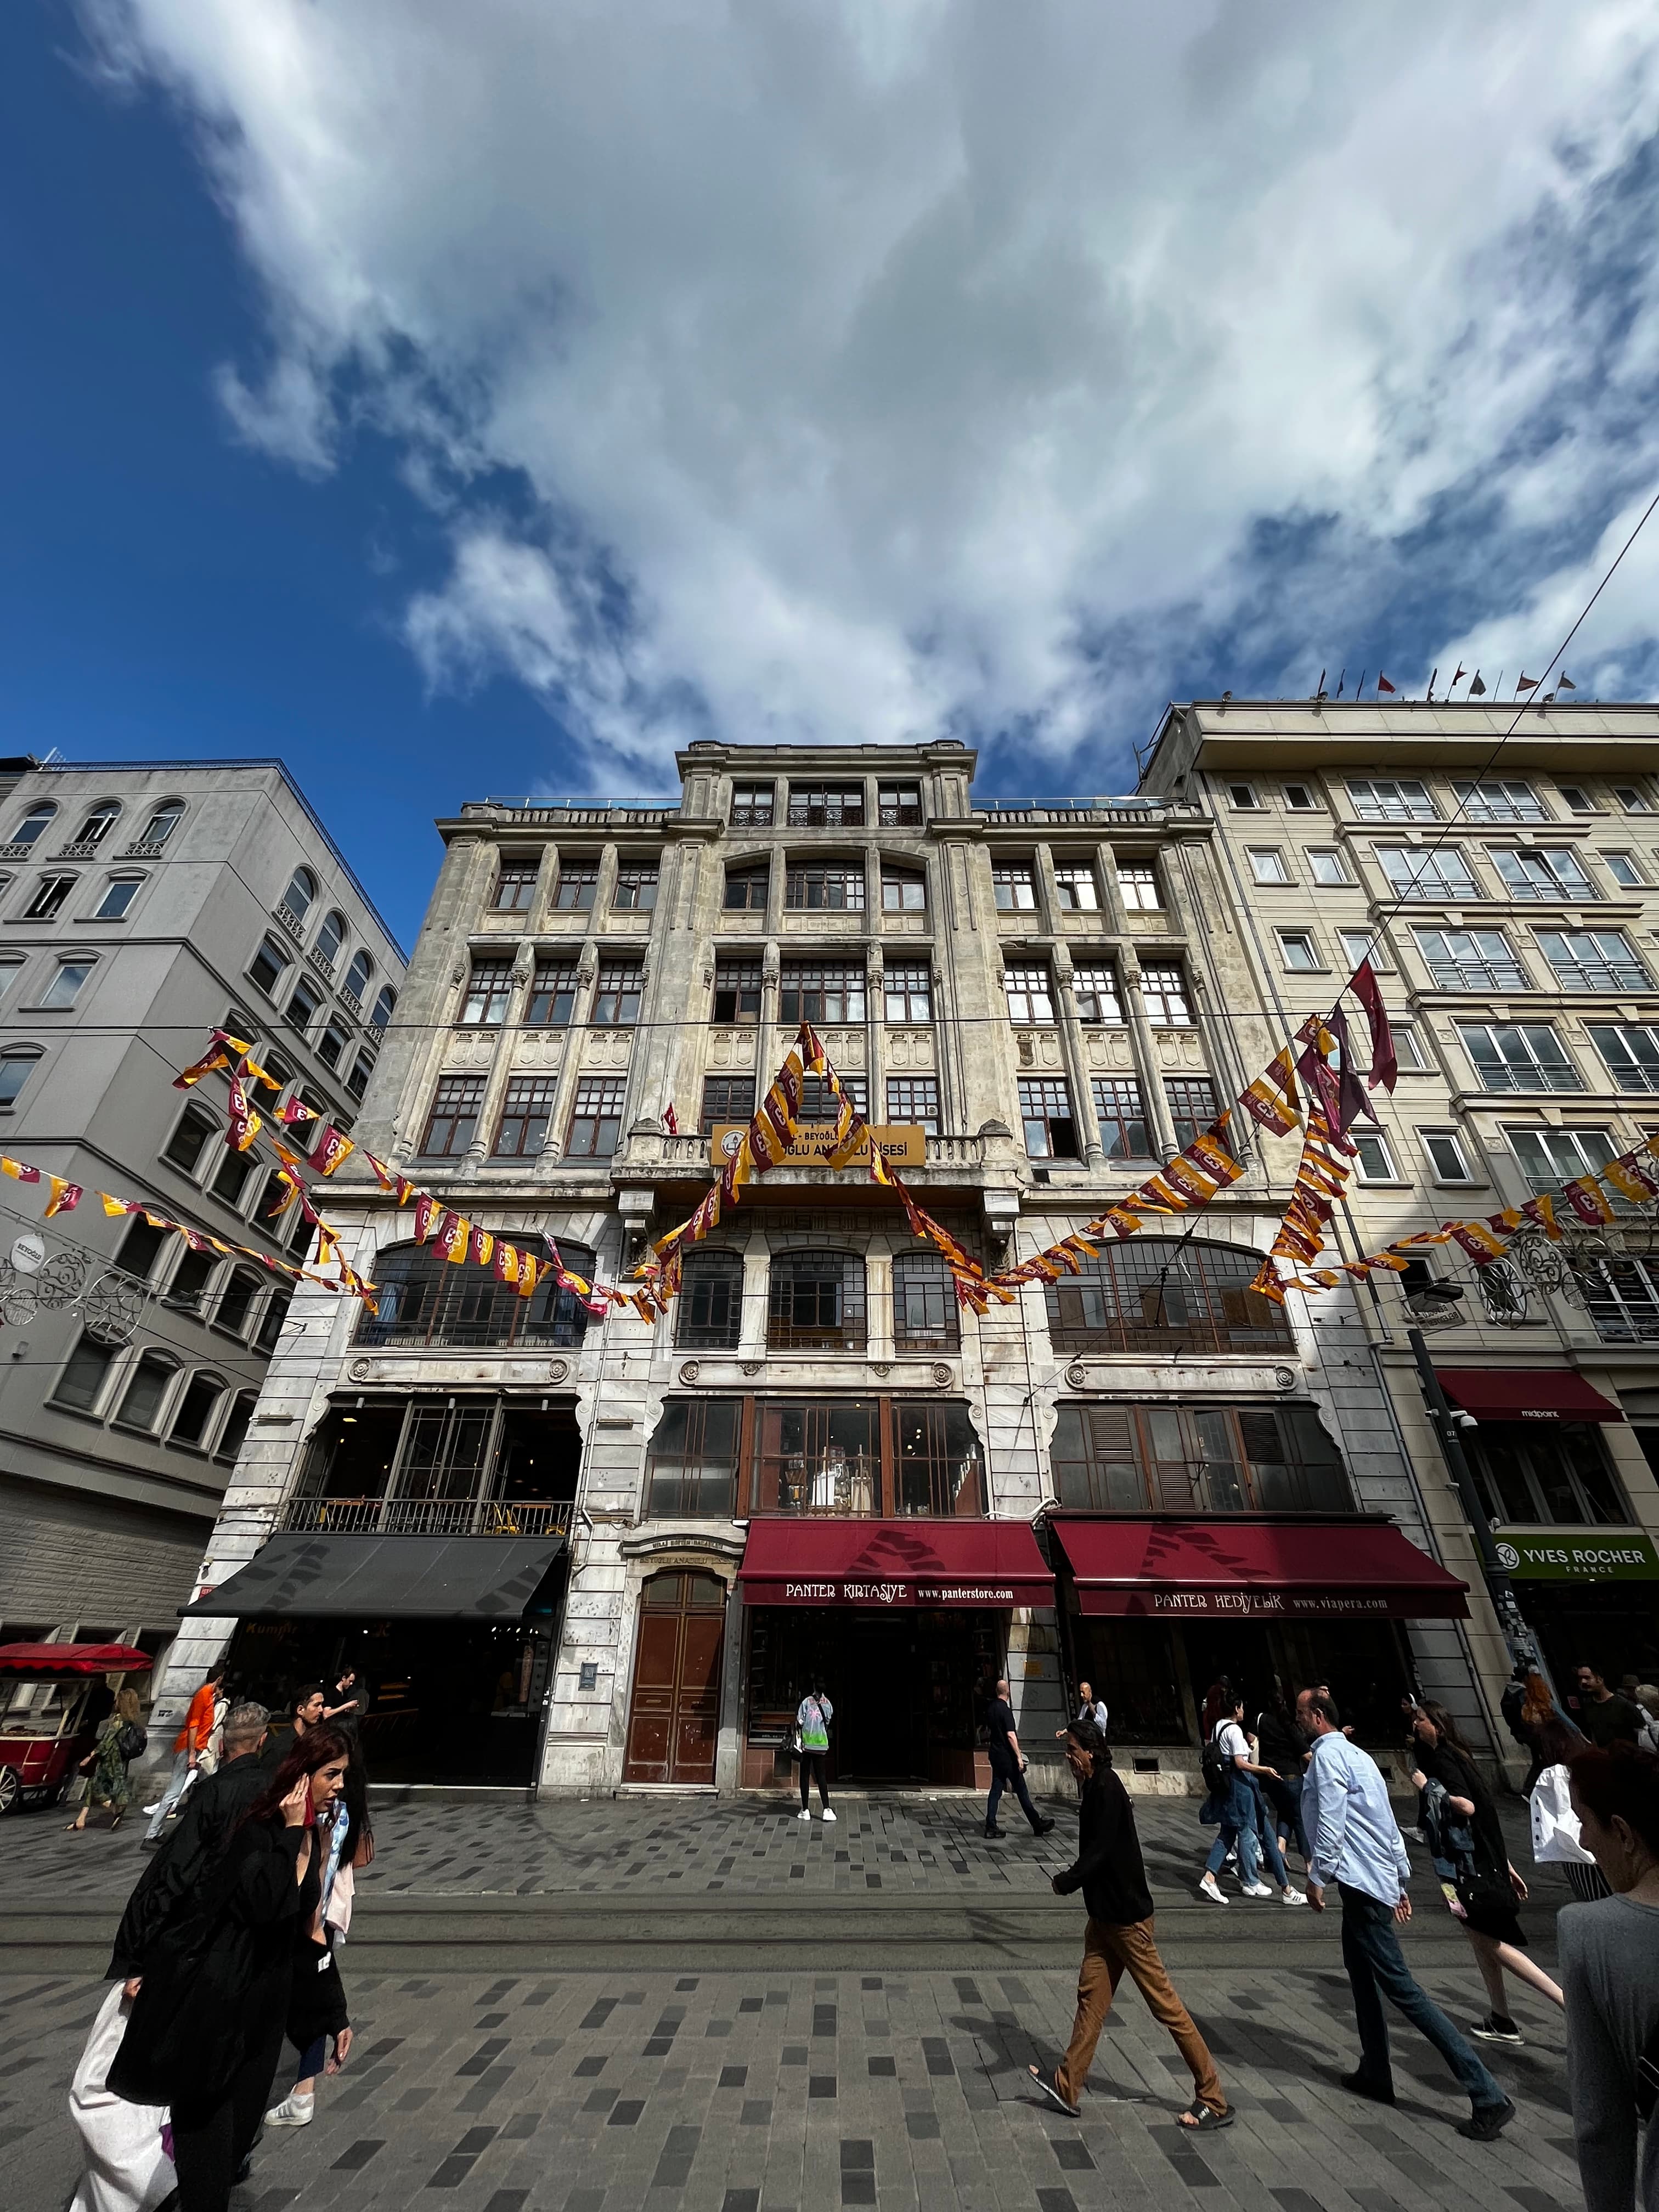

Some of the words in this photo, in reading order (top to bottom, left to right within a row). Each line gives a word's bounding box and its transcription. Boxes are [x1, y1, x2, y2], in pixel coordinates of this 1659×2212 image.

[879, 1142, 907, 1155] İSESİ
[1523, 1550, 1568, 1562] YVES
[1572, 1550, 1646, 1564] ROCHER
[786, 1584, 836, 1597] PANTER
[918, 1587, 1013, 1600] www.panterstore.com
[1154, 1594, 1207, 1607] PANTER
[1293, 1596, 1388, 1611] www.viapera.com
